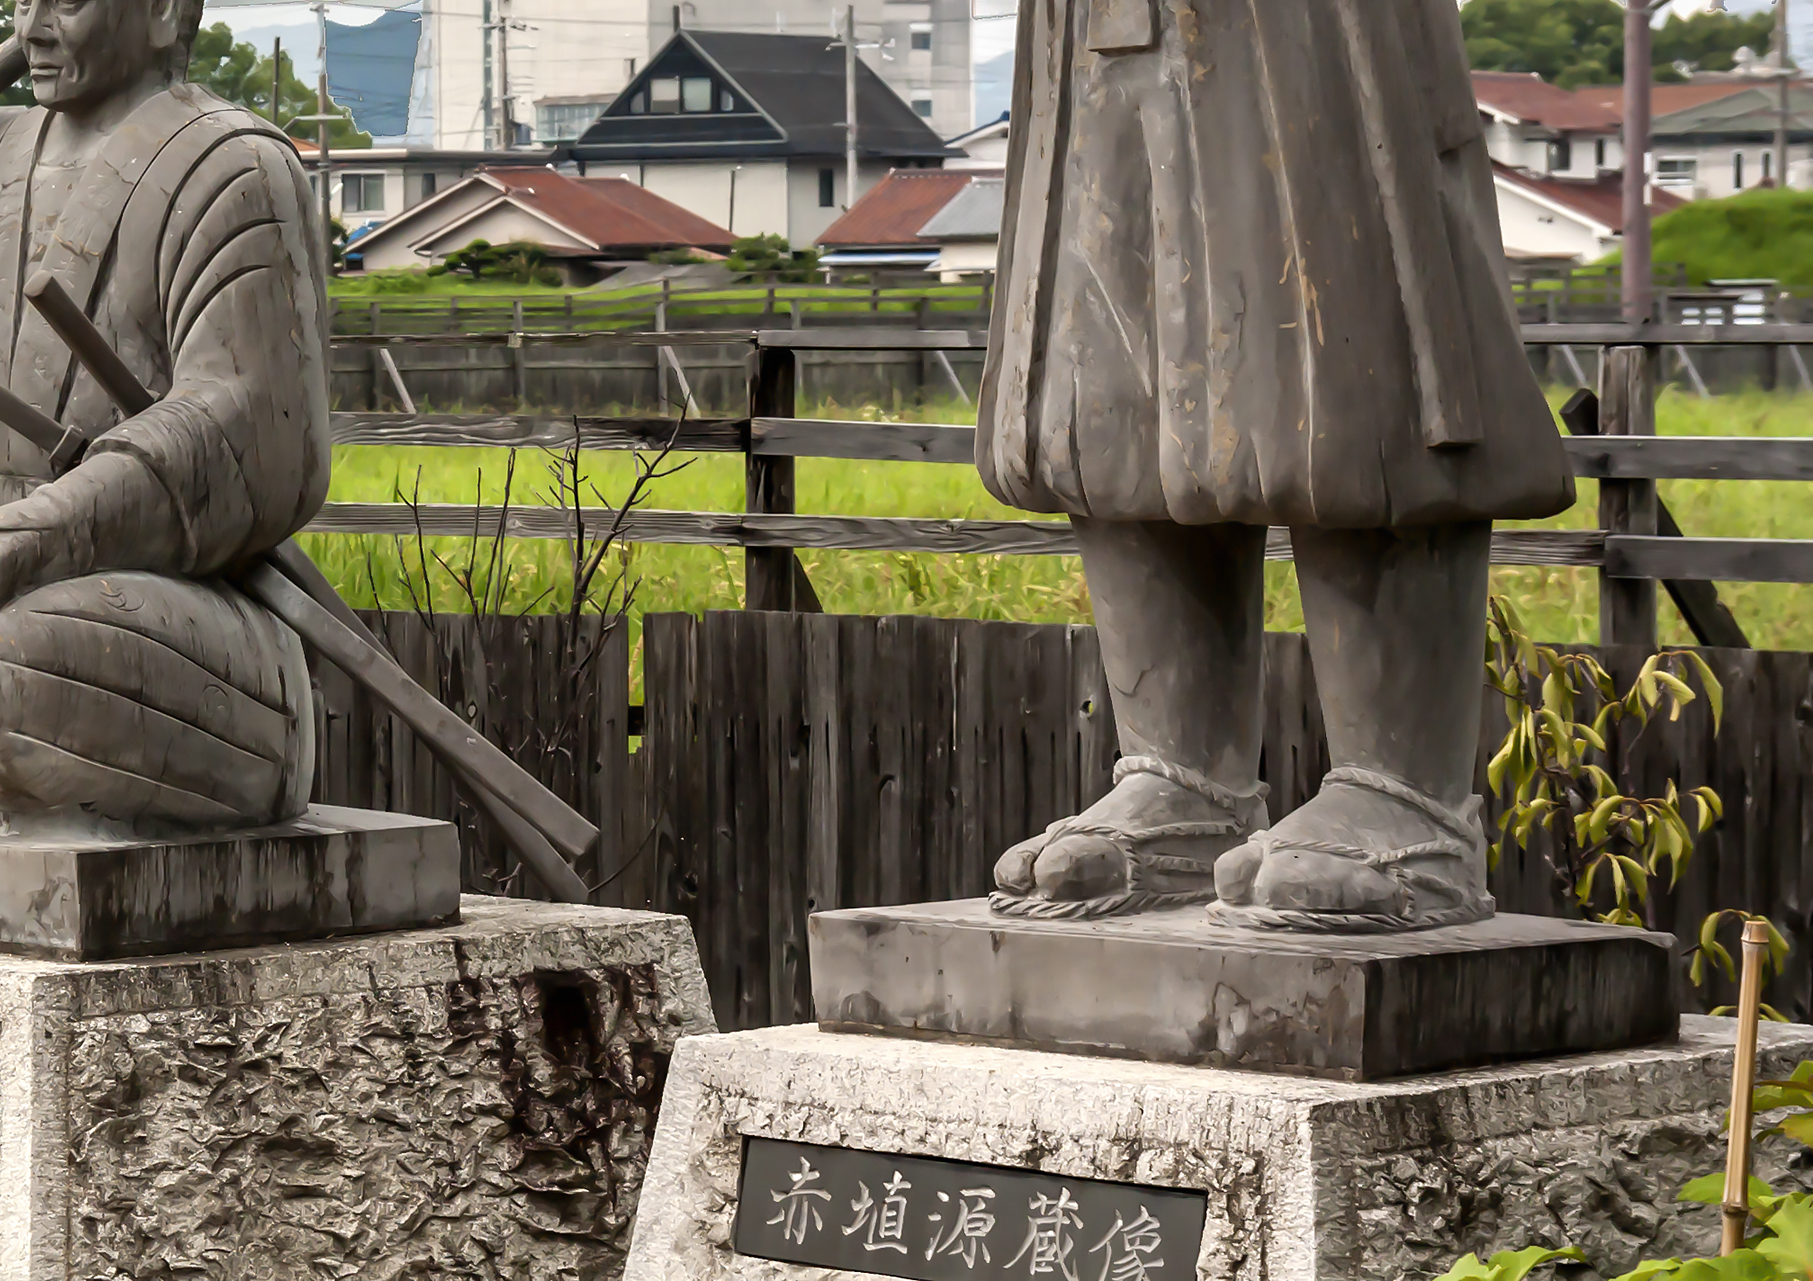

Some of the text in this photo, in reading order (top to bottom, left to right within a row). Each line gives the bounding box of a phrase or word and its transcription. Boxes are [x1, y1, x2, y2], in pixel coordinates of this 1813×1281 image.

[765, 1156, 1165, 1281] 赤埴源蔵像
